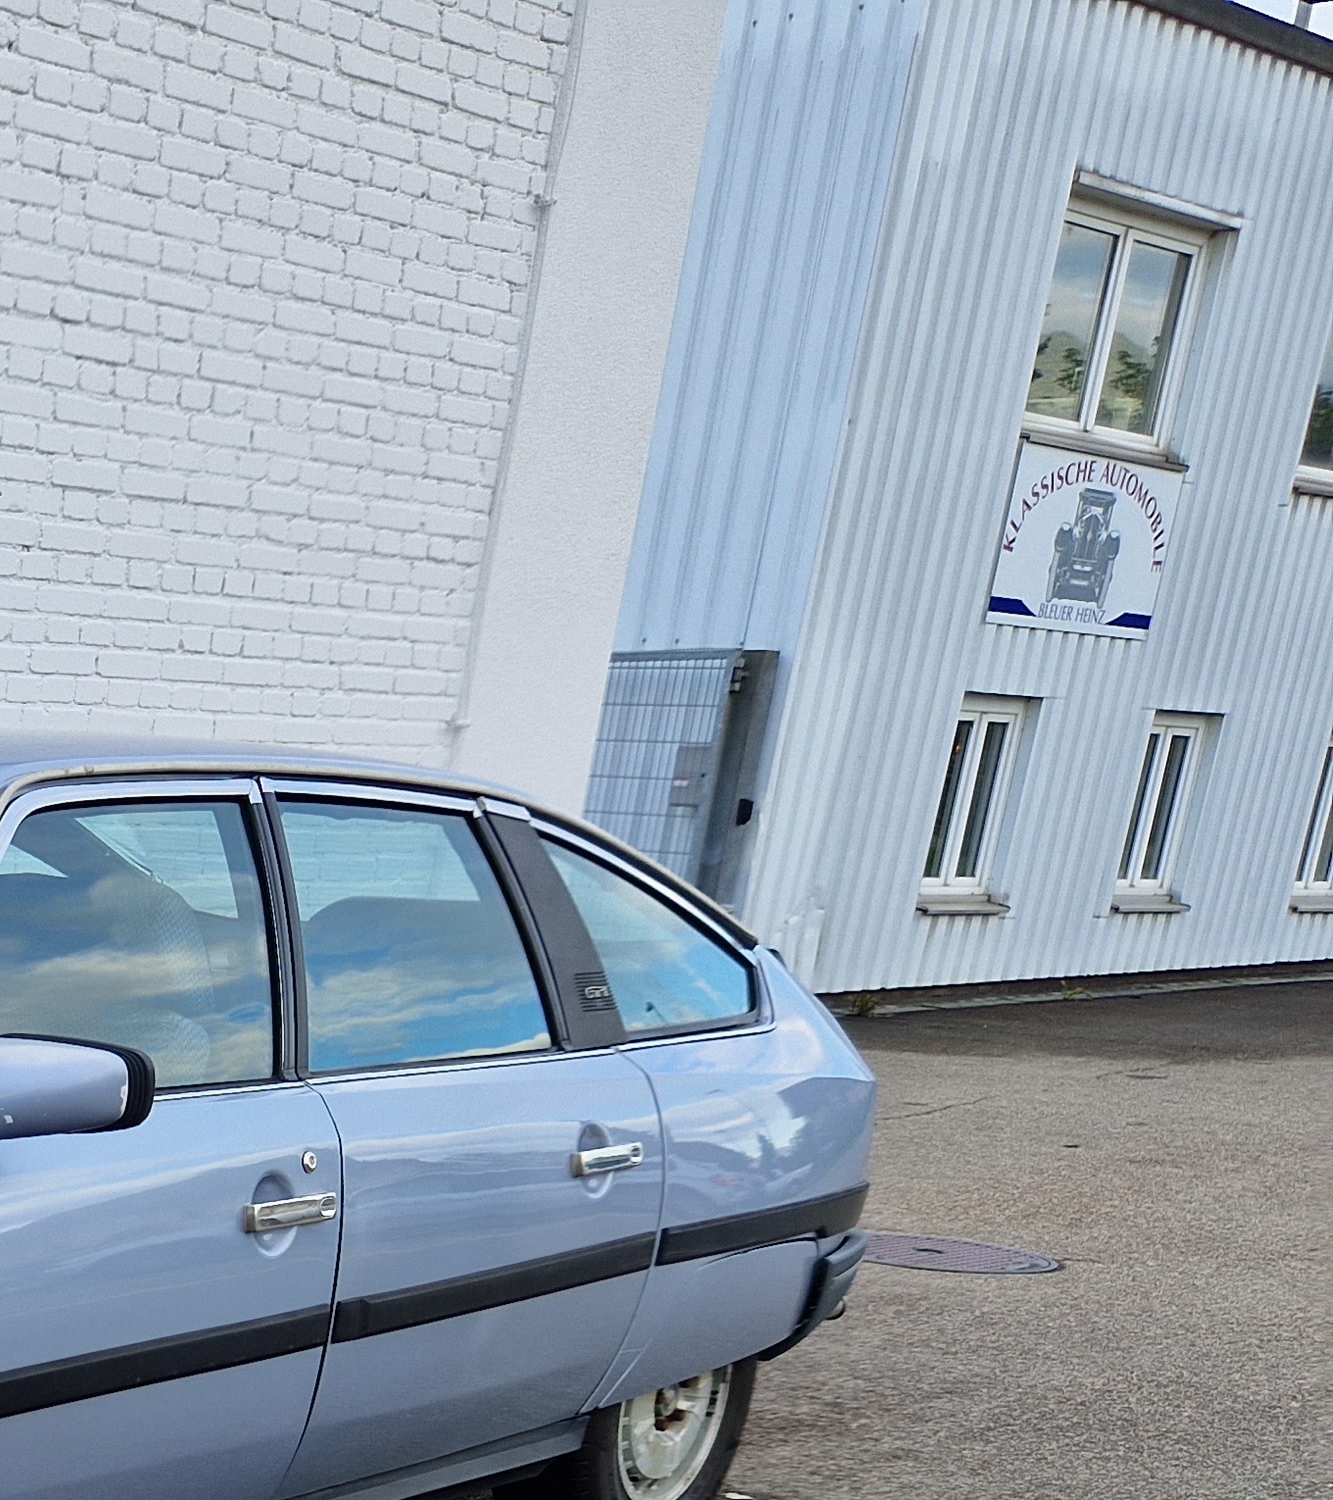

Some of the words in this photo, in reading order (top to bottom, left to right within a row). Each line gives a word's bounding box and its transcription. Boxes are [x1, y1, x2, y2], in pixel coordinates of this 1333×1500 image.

[1003, 461, 1096, 552] KLASSISCHE
[1101, 462, 1166, 572] AUTOMOBILE
[1037, 602, 1073, 621] BLEUER
[1075, 607, 1107, 625] HEINZ
